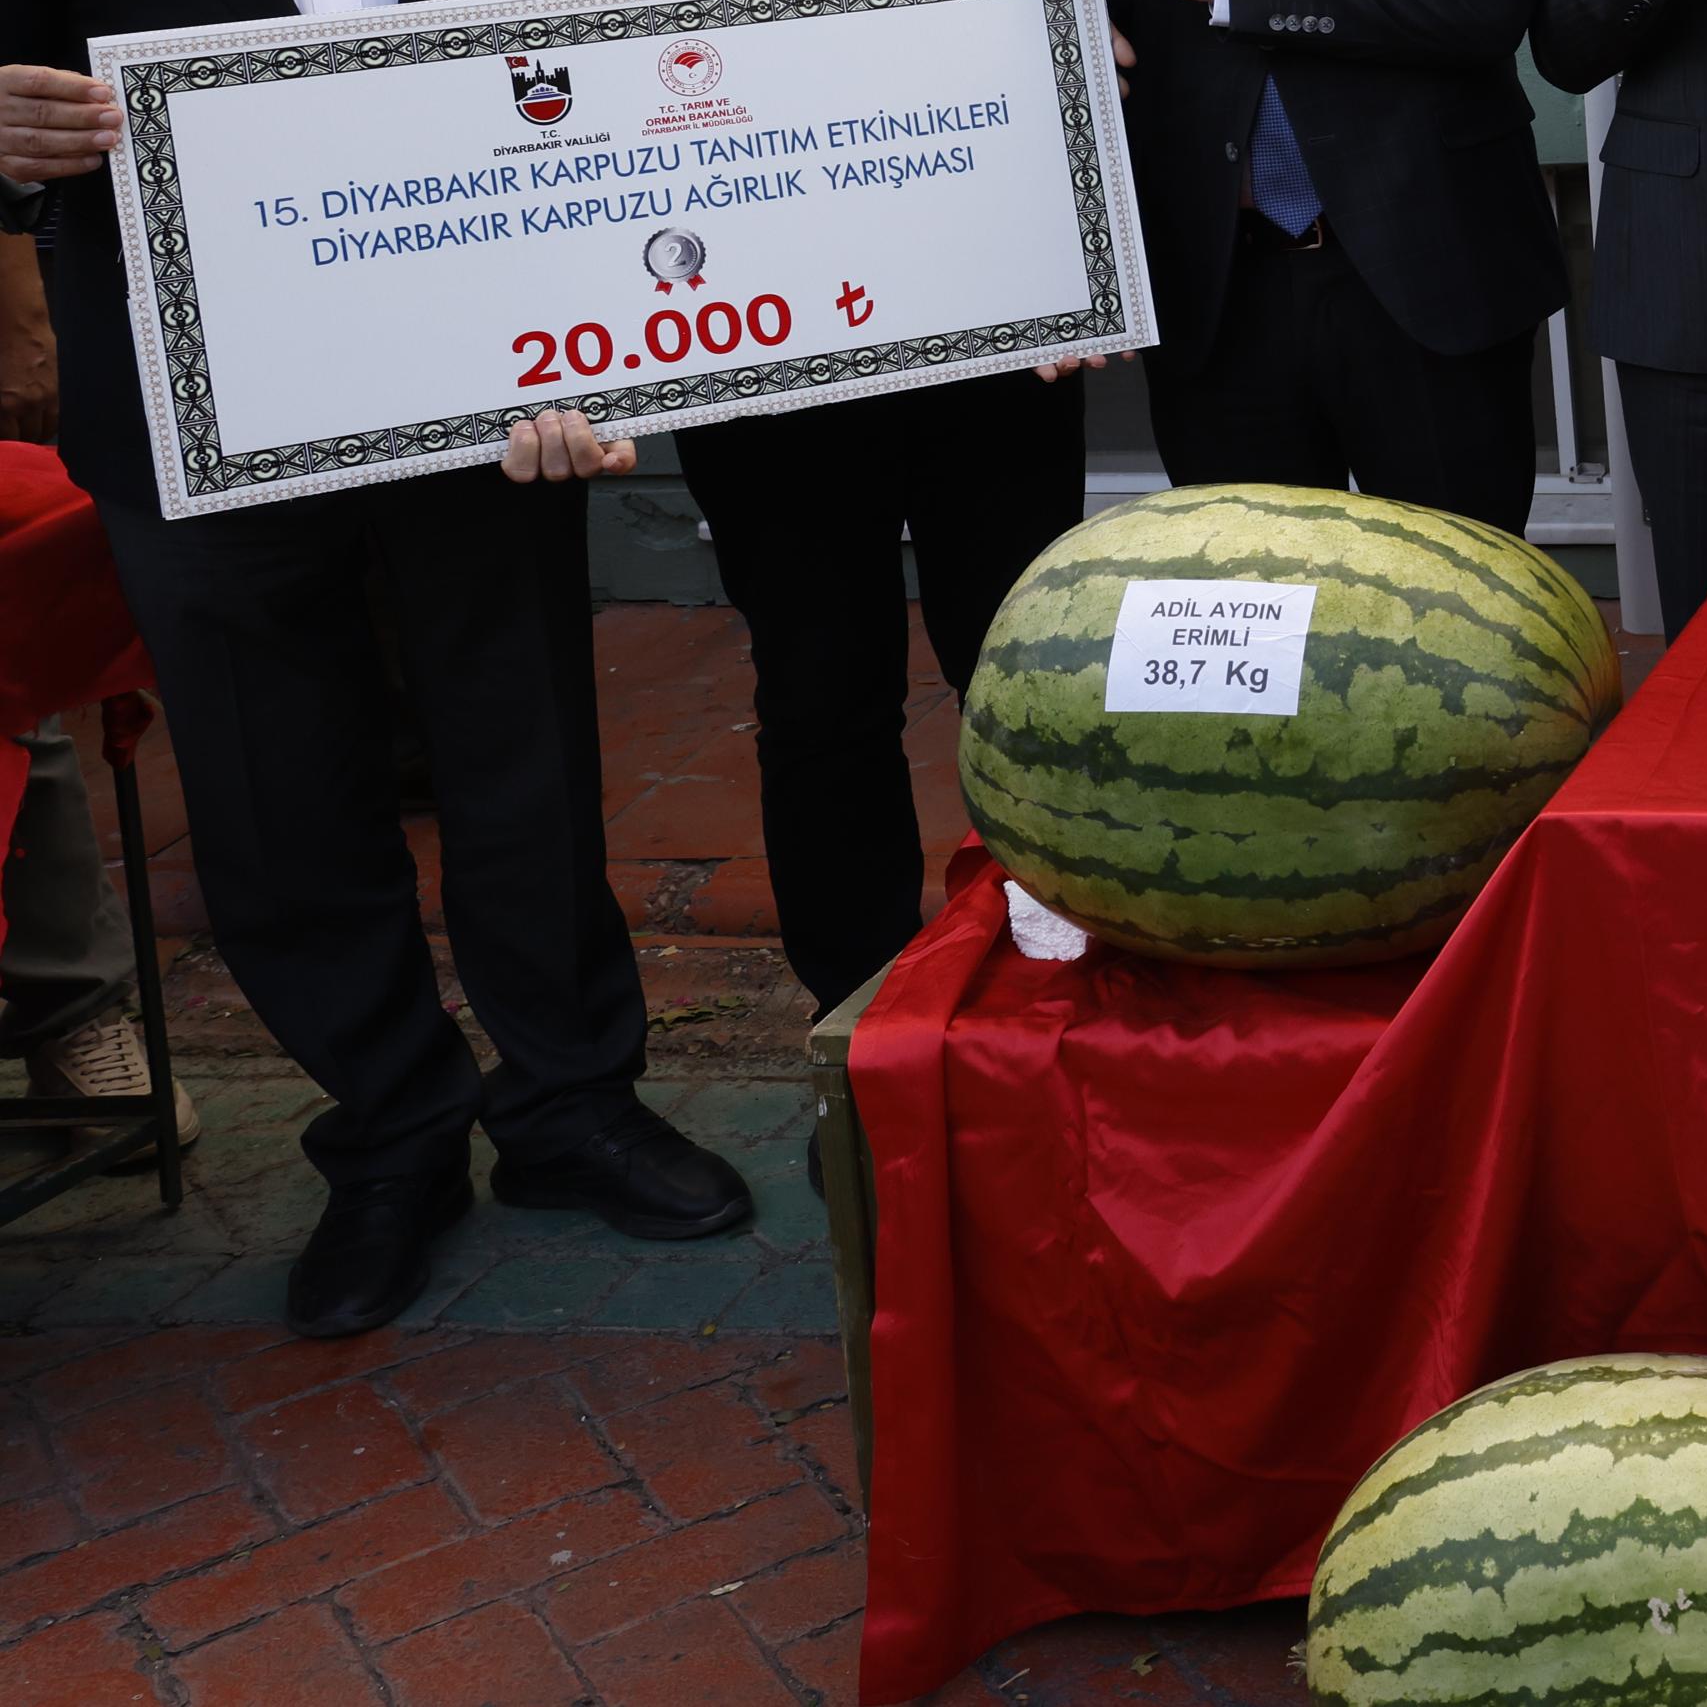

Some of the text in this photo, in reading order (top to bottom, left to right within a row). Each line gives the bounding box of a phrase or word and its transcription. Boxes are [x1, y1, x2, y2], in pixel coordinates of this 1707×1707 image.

[645, 105, 747, 128] ORMAN BAKANLIĞI
[659, 97, 731, 114] T.C. TARIM VE
[540, 130, 561, 139] T.C.
[641, 115, 754, 137] DİYARBAKIR İL MÜDÜRLÜĞÜ
[493, 131, 611, 157] DİYARBAKIR VALİLİĞİ
[254, 93, 1010, 228] 15. DİYARBAKIR KARPUZU TANITIM ETKİNLİKLERİ
[311, 145, 975, 267] DİYARBAKIR KARPUZU AĞIRLIK YARIŞMASI
[511, 293, 792, 388] 20.000
[1150, 598, 1283, 621] ADİL AYDIN
[1172, 625, 1251, 647] ERİMLİ
[1143, 659, 1269, 693] 38,7 Kg
